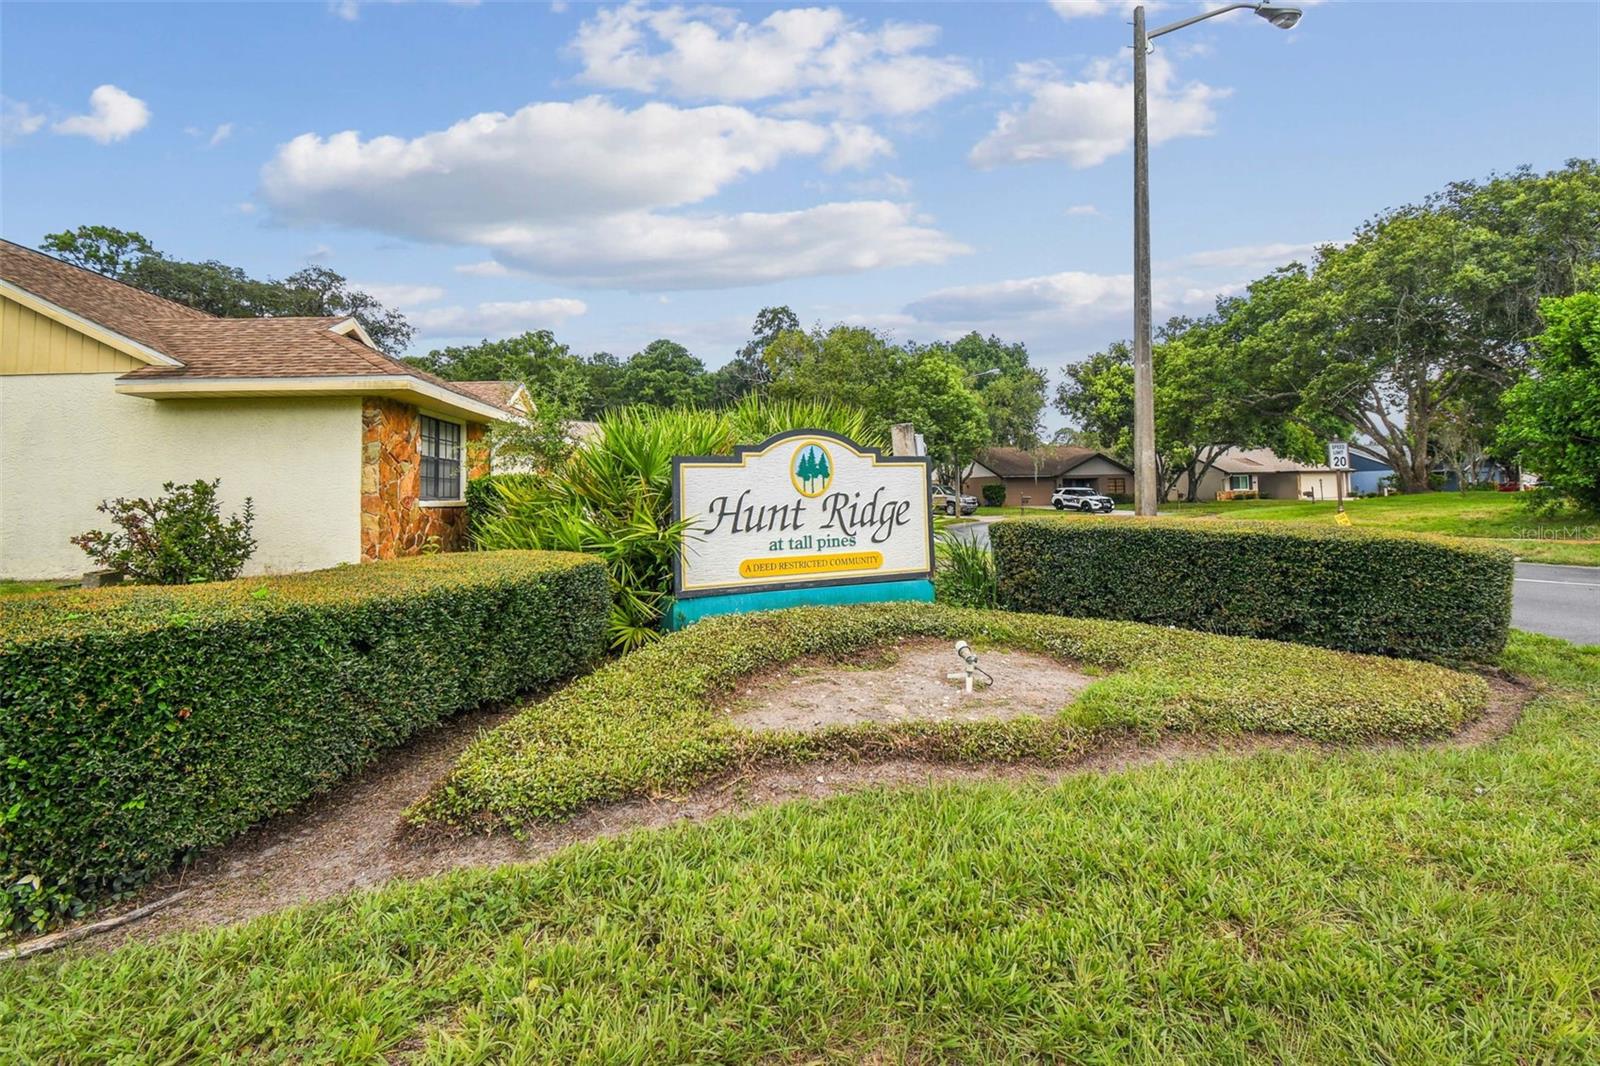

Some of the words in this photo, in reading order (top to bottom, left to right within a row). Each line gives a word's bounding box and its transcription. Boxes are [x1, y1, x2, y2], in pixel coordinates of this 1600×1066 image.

[1333, 456, 1346, 467] 20
[703, 489, 807, 535] Hunt
[819, 486, 911, 543] Ridge
[769, 537, 784, 551] at
[789, 535, 812, 550] tall
[817, 534, 857, 552] pines
[745, 565, 752, 573] A
[753, 562, 777, 572] DEED
[779, 558, 828, 570] RESTRICTED
[829, 555, 880, 567] COMMUNITY
